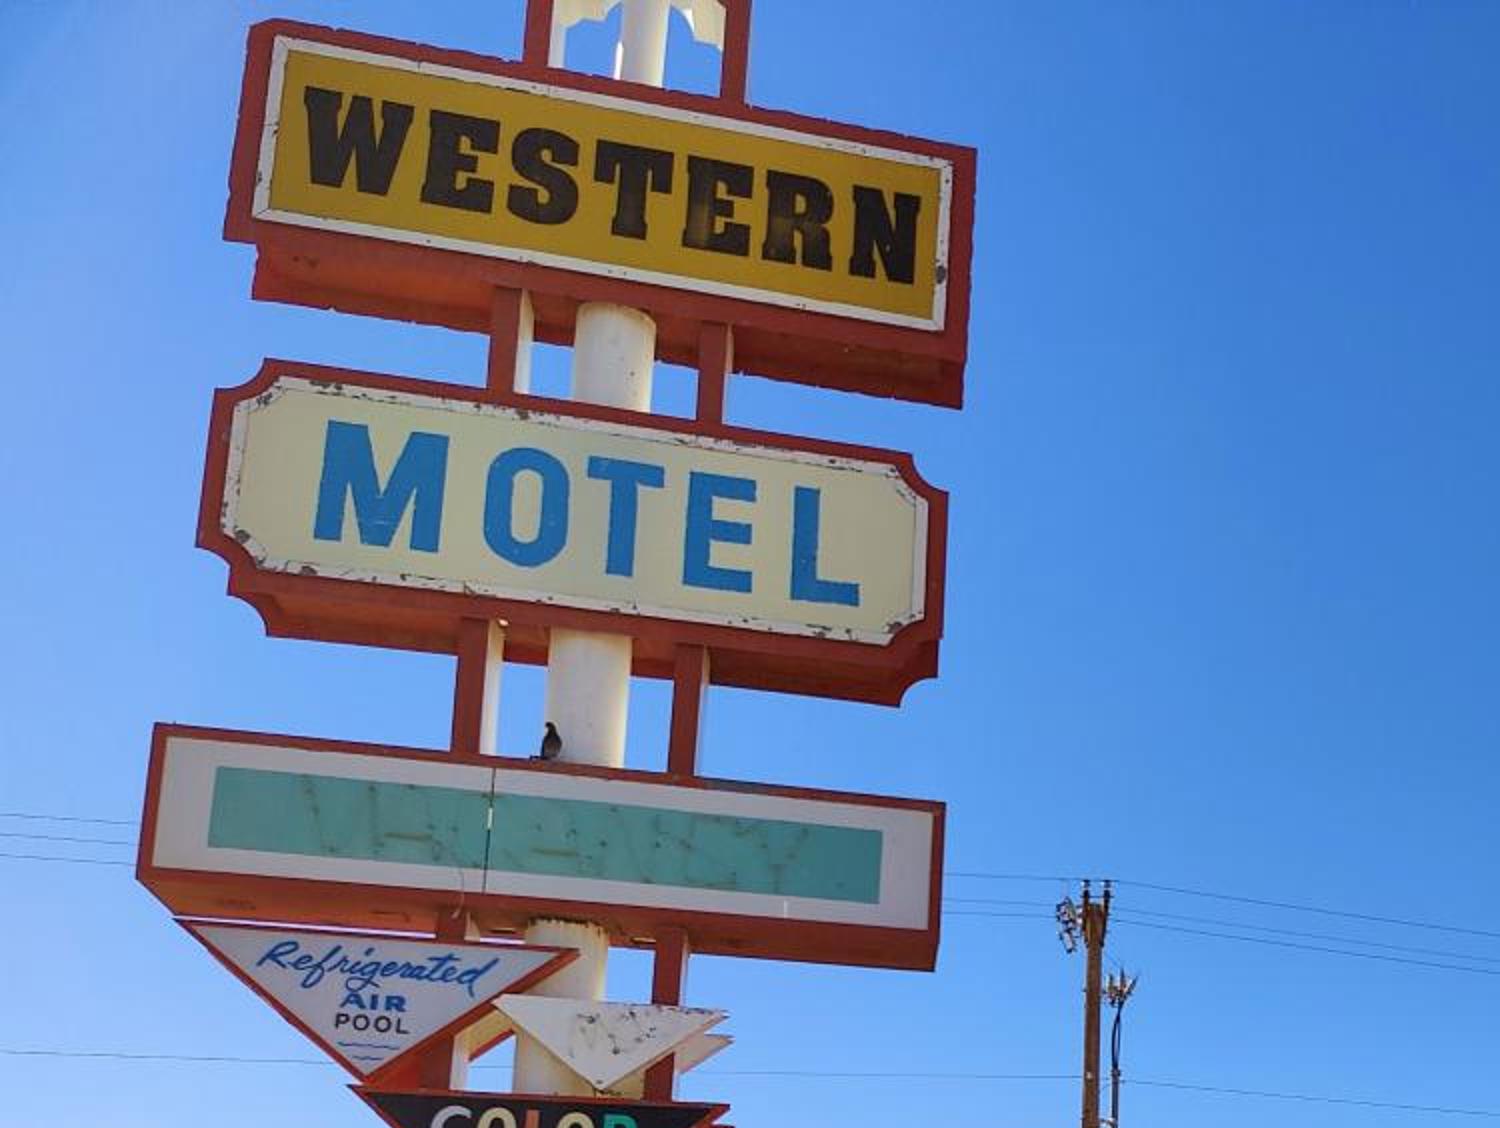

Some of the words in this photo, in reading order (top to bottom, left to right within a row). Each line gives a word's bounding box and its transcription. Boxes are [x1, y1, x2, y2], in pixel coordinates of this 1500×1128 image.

[303, 86, 921, 285] WESTERN
[313, 420, 860, 606] MOTEL
[256, 941, 499, 998] Refrigerated
[335, 1013, 410, 1034] POOL
[340, 993, 407, 1013] AIR
